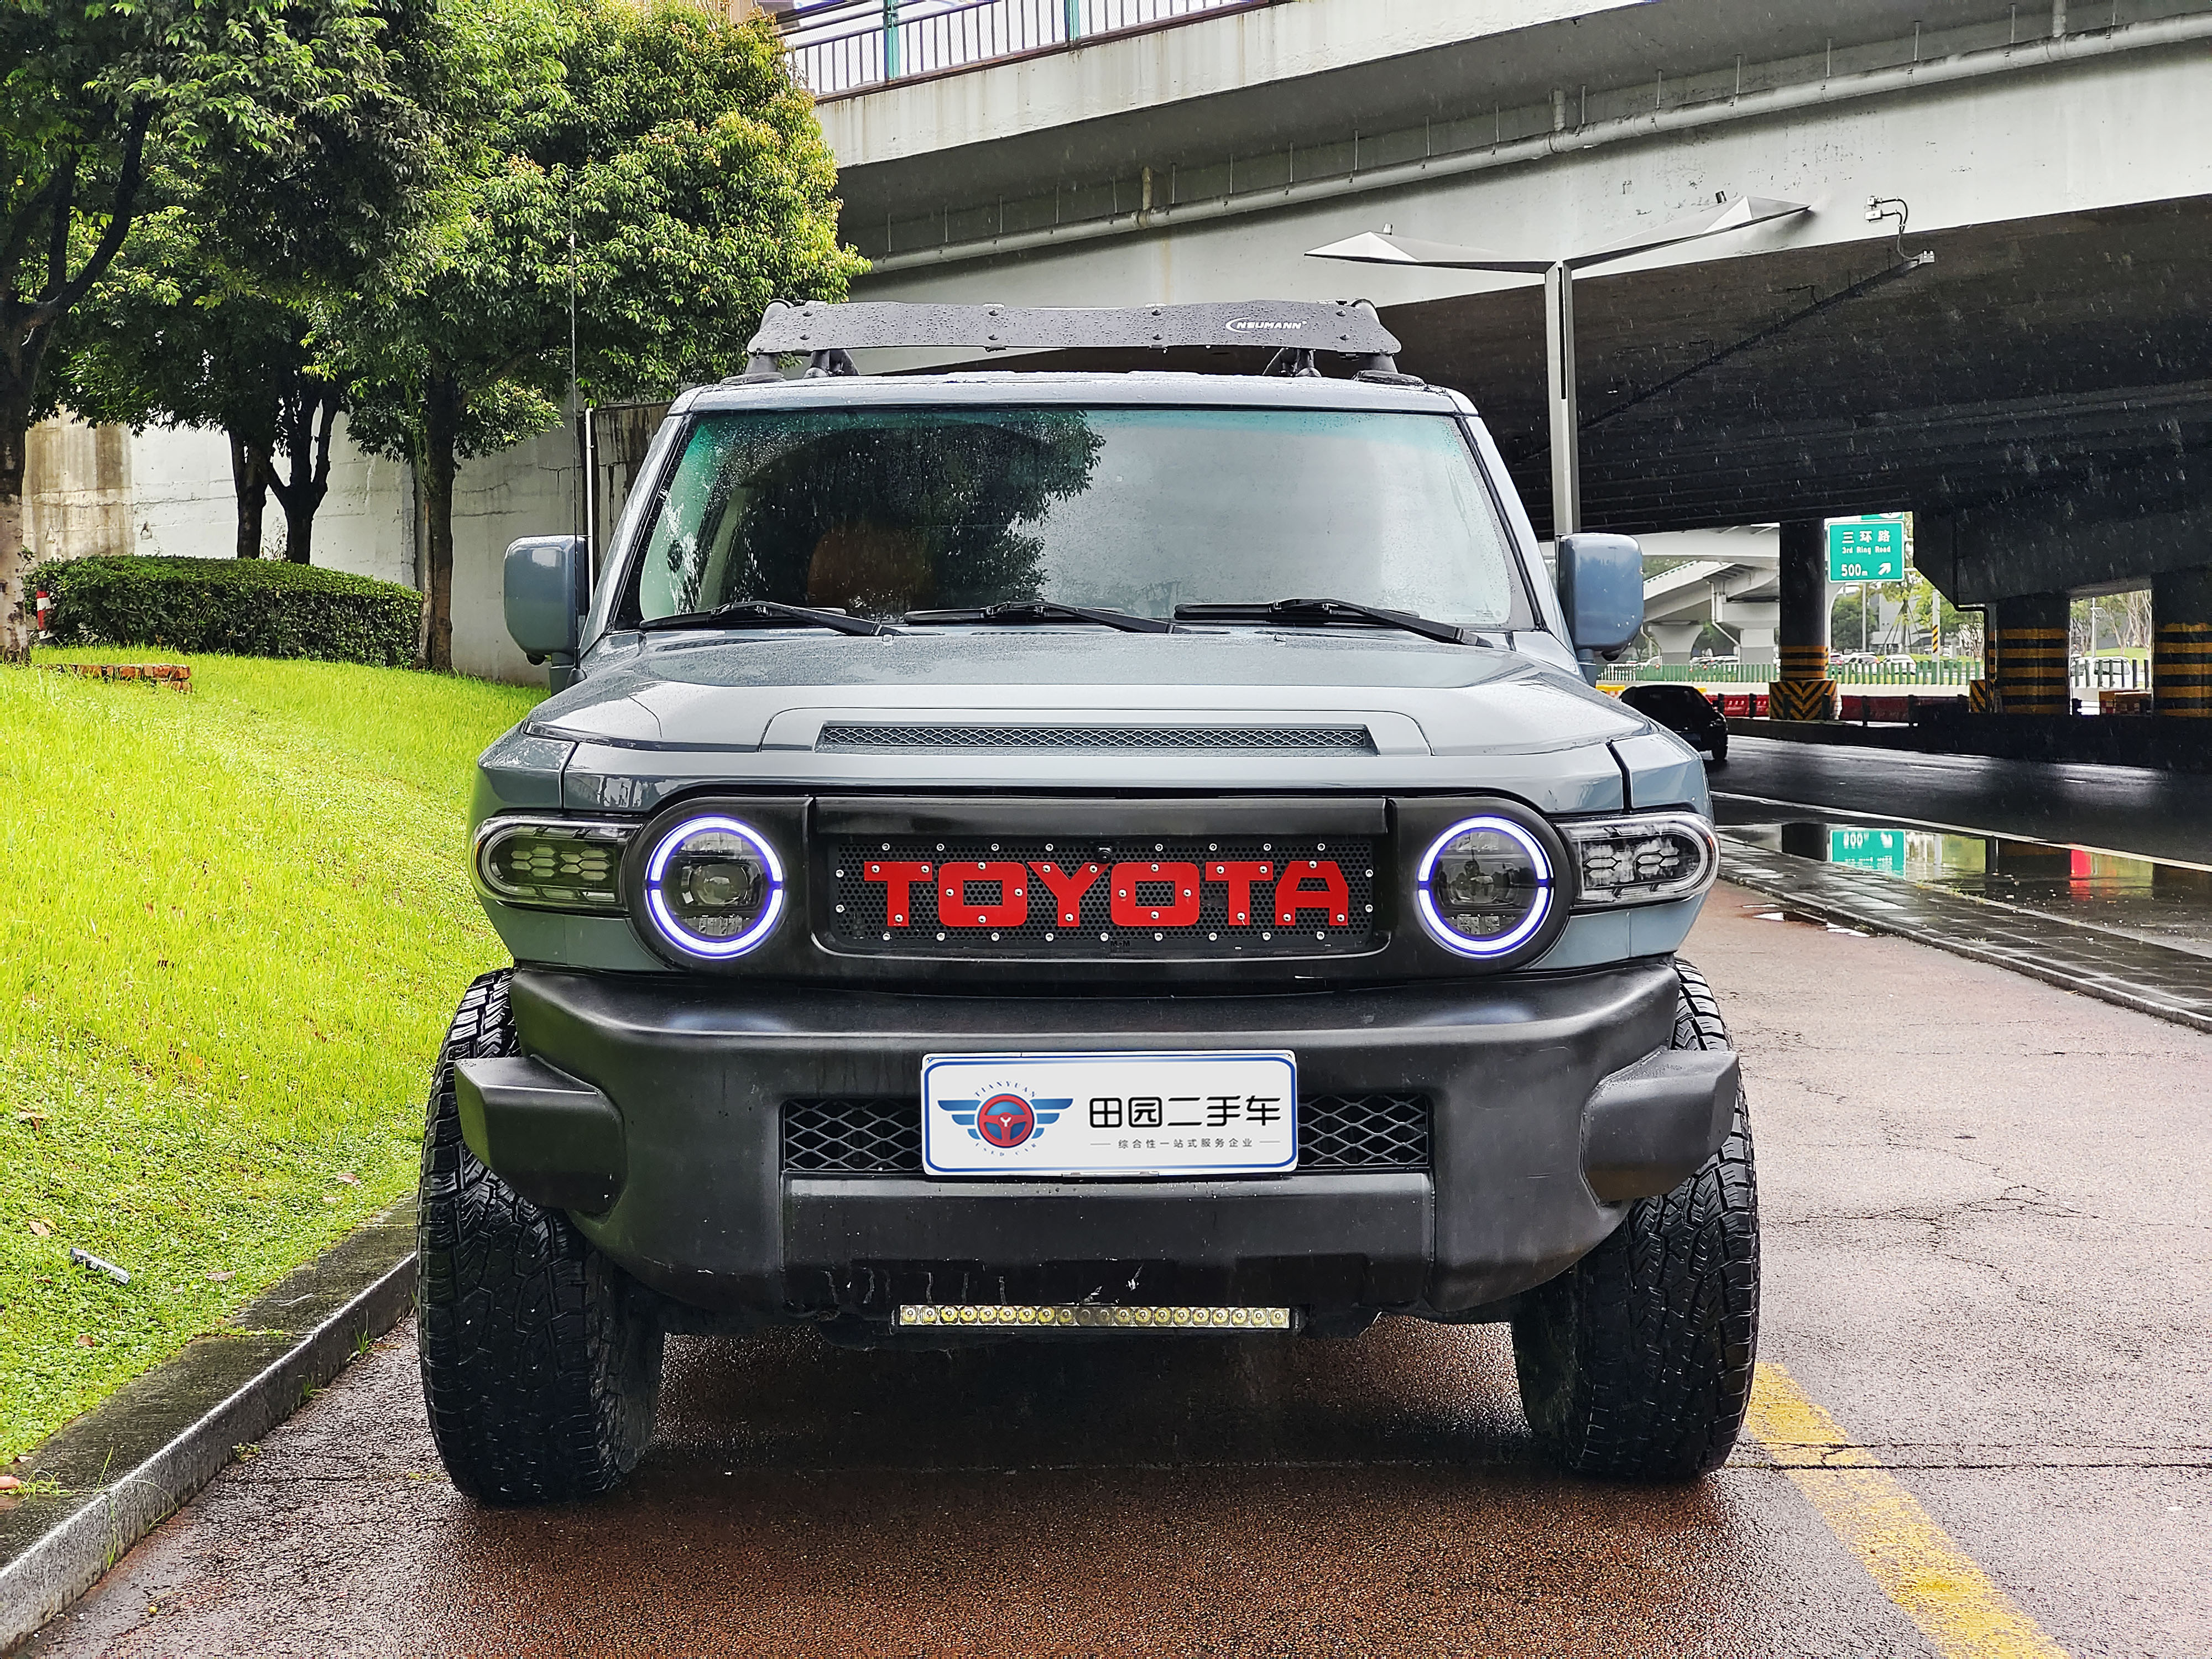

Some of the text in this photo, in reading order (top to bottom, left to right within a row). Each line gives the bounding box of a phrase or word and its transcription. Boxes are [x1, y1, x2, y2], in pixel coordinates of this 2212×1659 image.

[1237, 321, 1302, 330] NEUMANN
[1842, 530, 1890, 544] 三环路
[1856, 546, 1871, 555] Ring
[864, 860, 1349, 927] TOYOTA
[1089, 1095, 1281, 1128] 田园二手车
[1118, 1138, 1253, 1149] 综合性一站式服务企业
